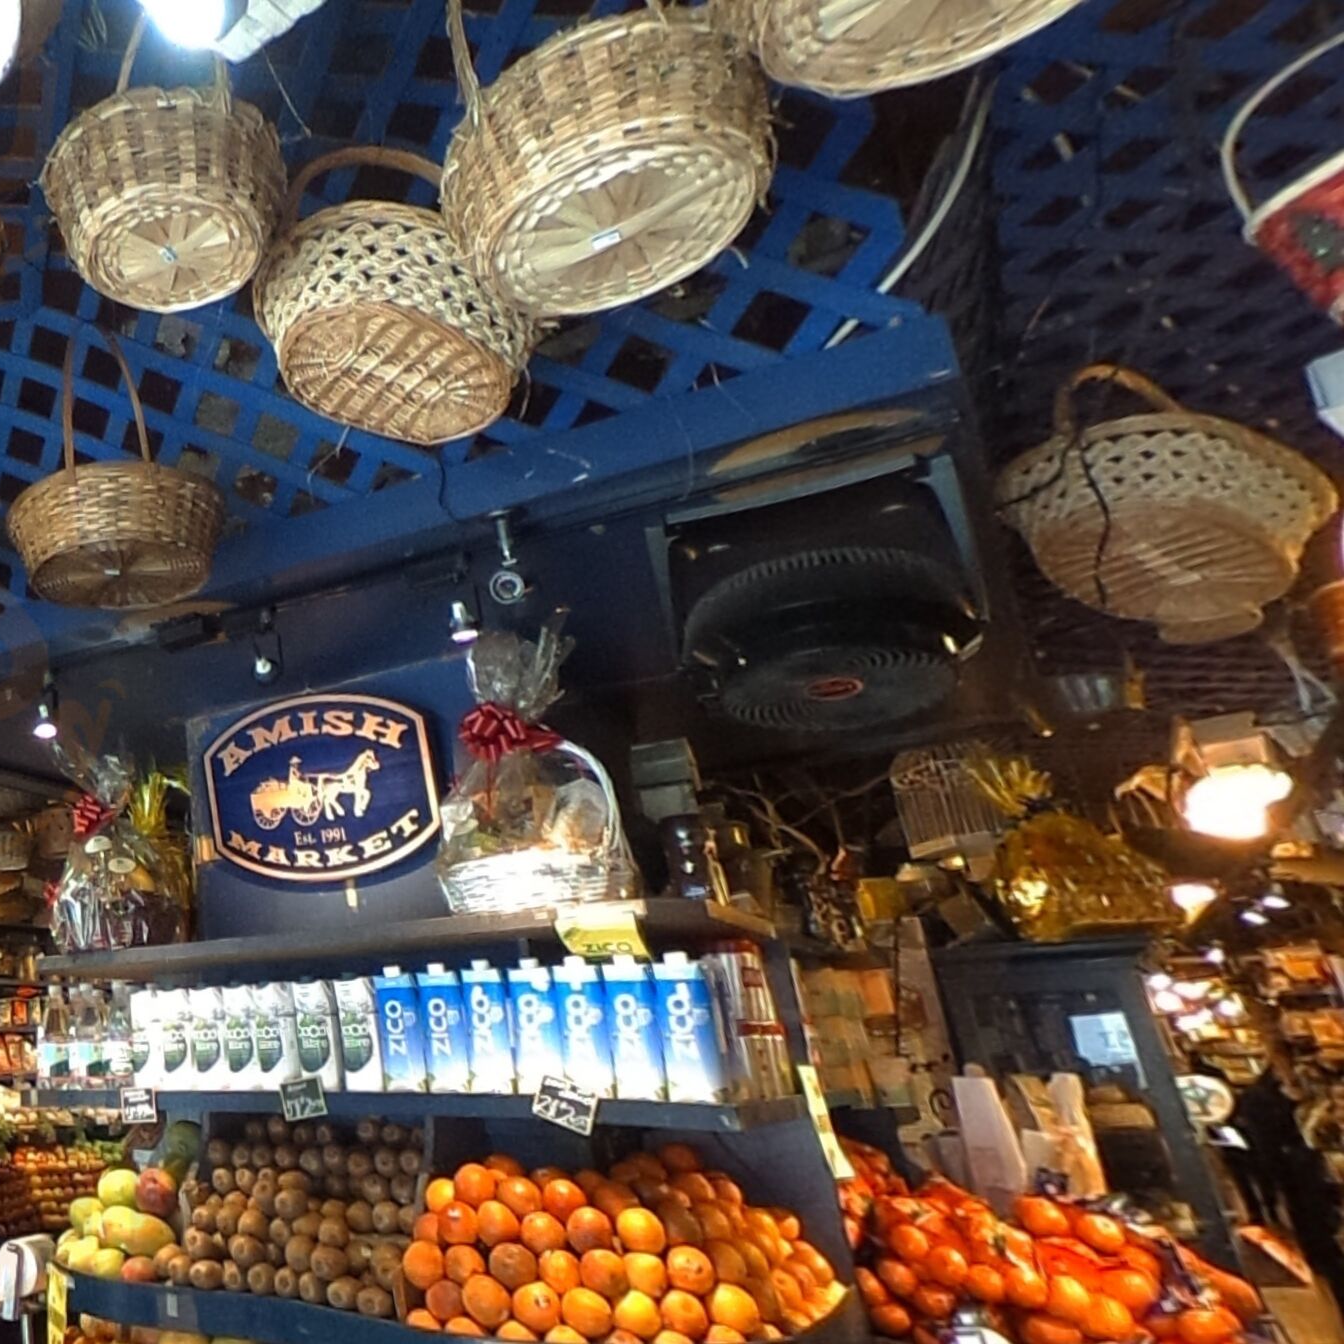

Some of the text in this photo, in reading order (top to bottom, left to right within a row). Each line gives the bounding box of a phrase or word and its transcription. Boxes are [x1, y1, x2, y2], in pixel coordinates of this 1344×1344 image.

[217, 709, 410, 777] AMISH
[227, 808, 421, 868] MARKET
[320, 825, 347, 845] 1991
[581, 941, 633, 954] ZICO
[384, 999, 407, 1055] ZICO
[428, 998, 452, 1056] ZICO
